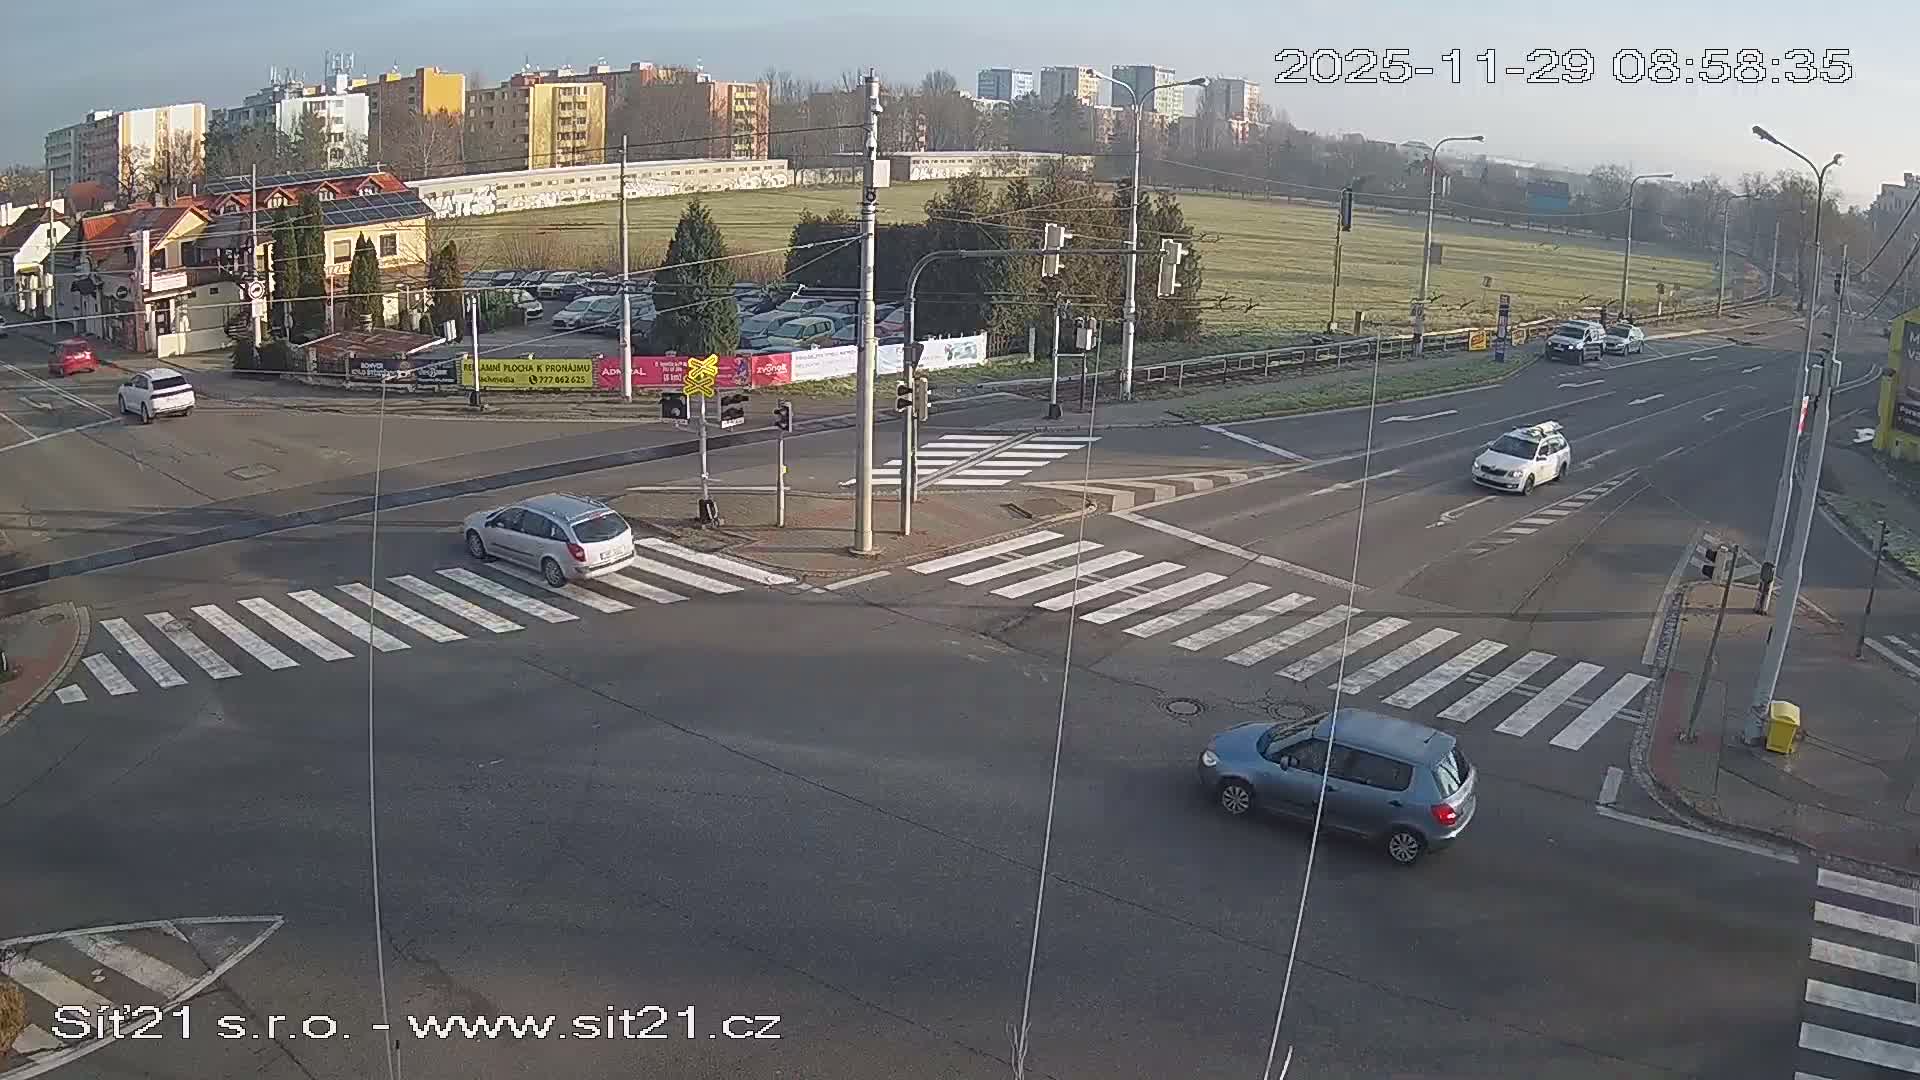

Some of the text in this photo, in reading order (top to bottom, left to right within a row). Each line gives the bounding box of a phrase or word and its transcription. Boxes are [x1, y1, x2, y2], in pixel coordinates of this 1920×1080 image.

[463, 361, 590, 373] REAMNÍ PLOCHA K PRONÁJMU
[539, 376, 553, 384] 777
[571, 376, 586, 384] 625
